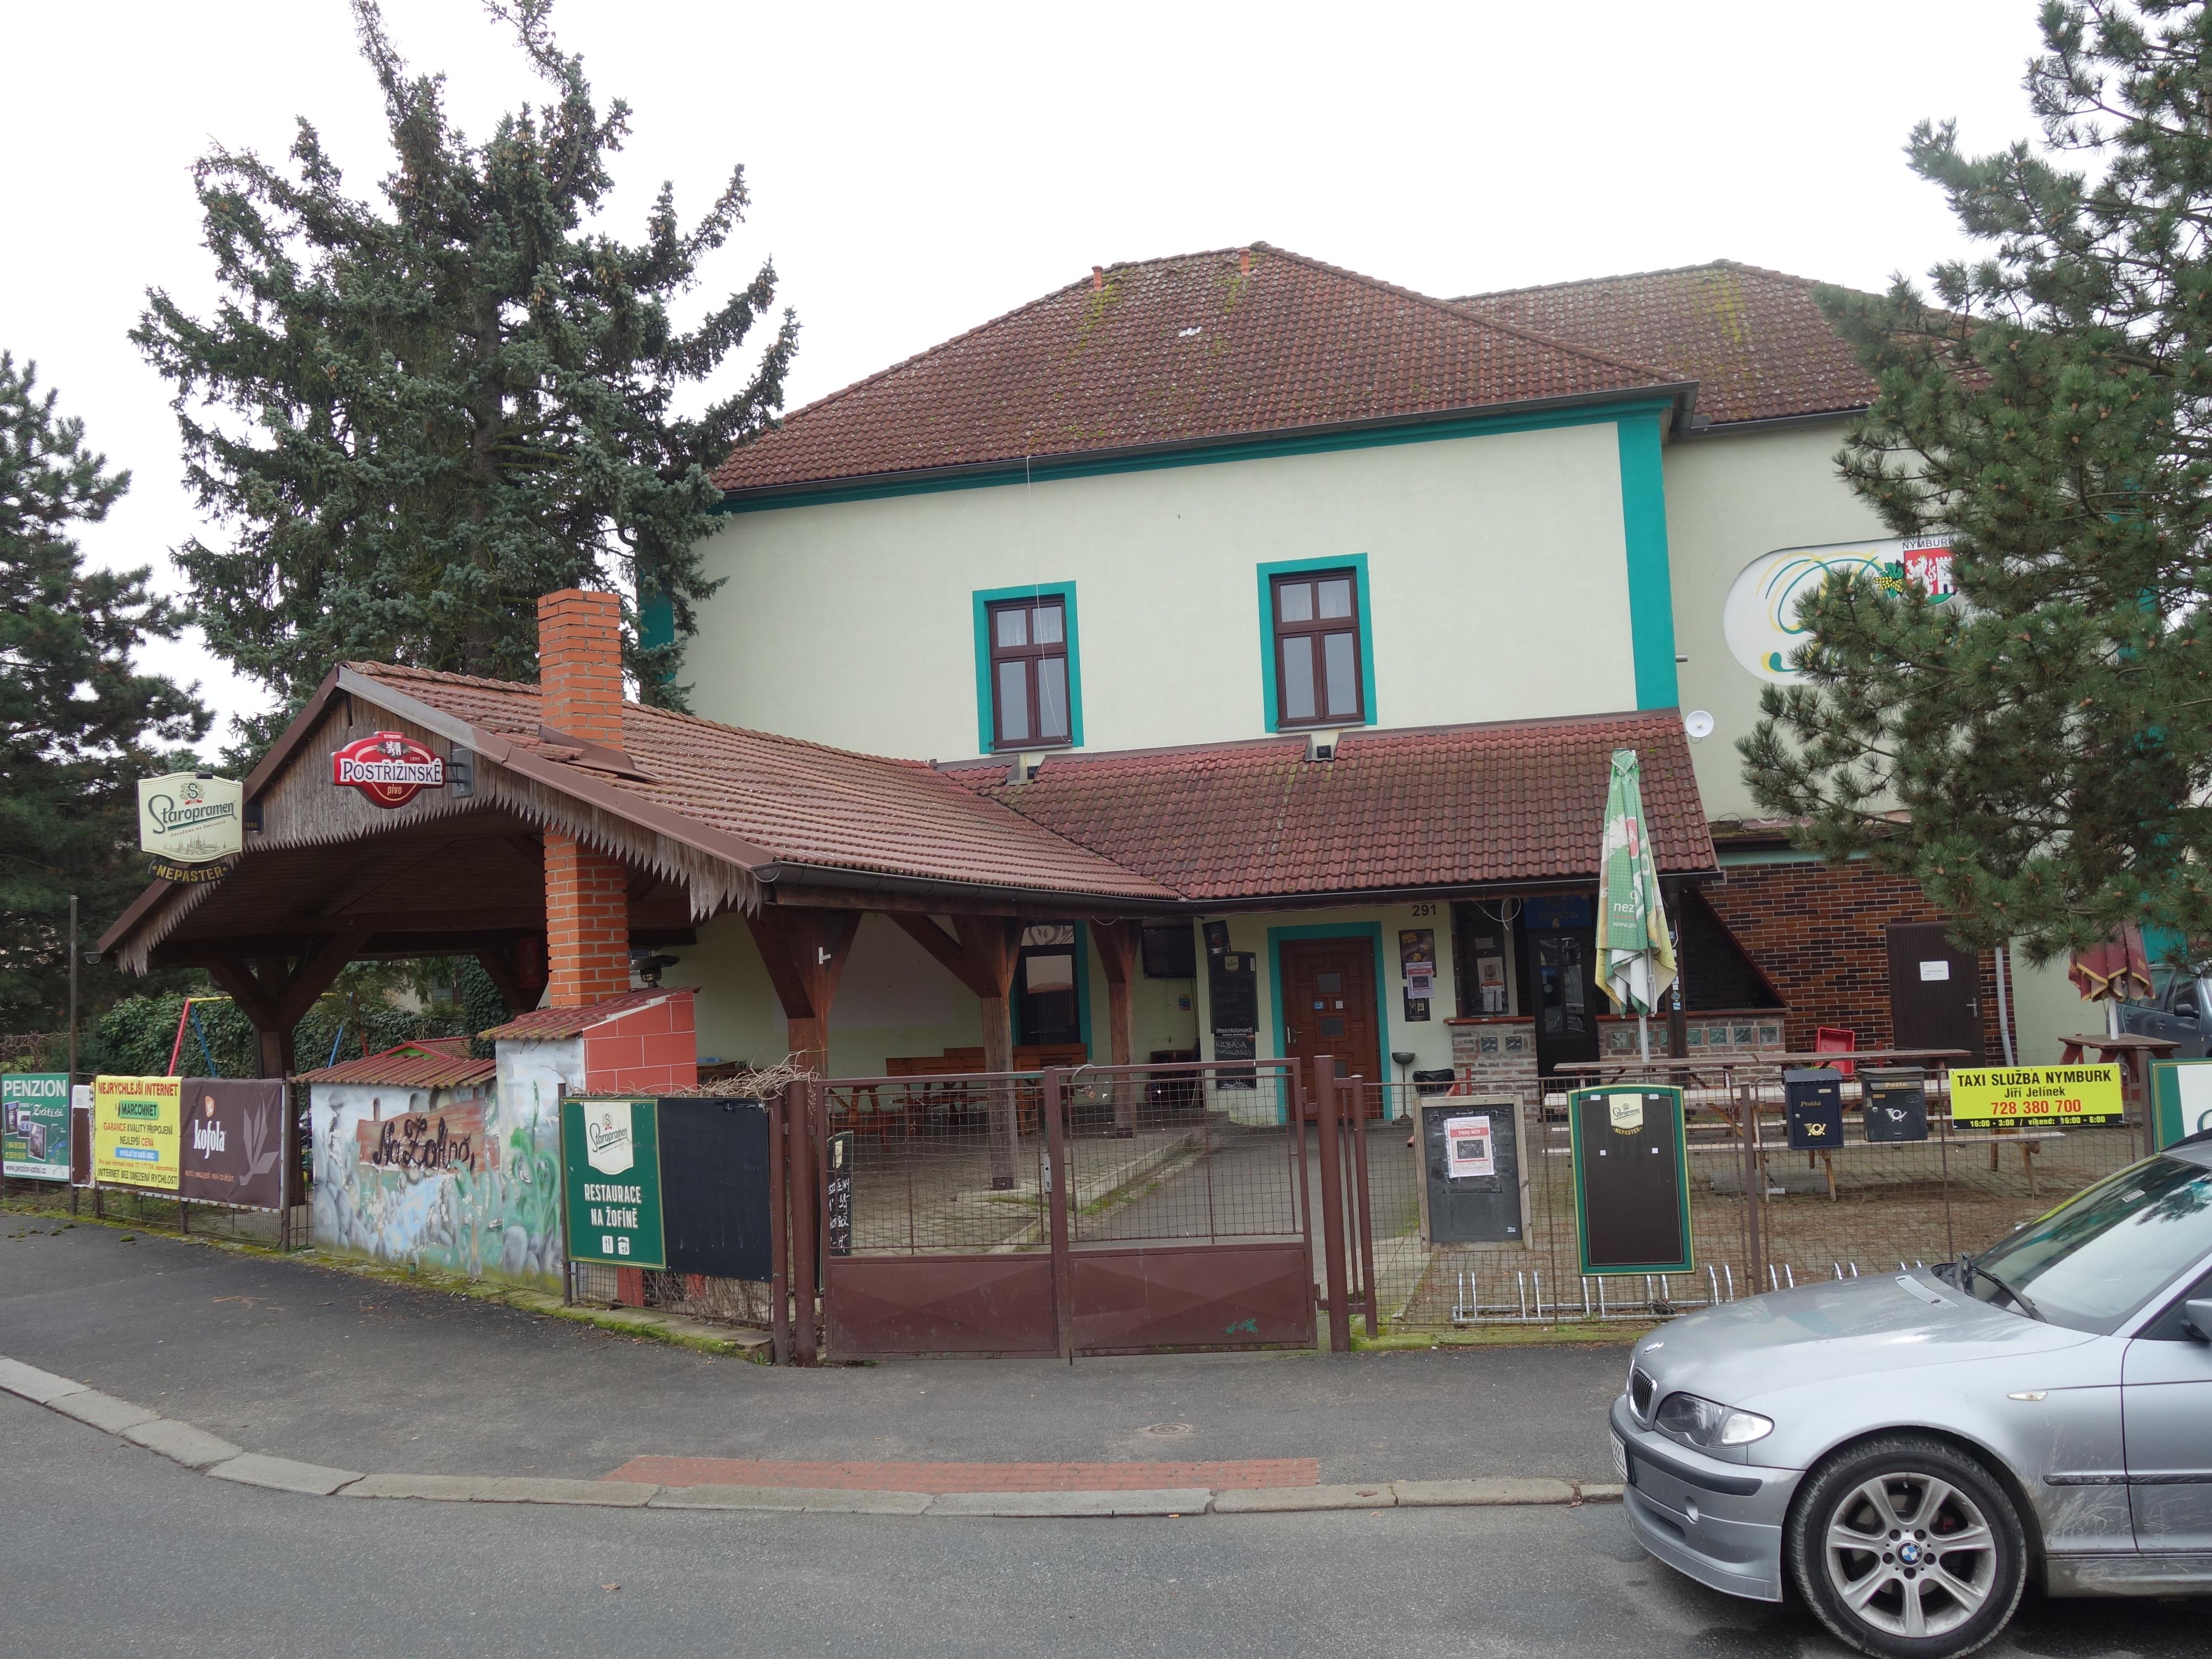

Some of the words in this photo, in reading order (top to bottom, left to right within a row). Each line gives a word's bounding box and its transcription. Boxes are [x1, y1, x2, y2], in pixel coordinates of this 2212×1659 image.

[343, 760, 441, 782] POSTŘIŽINSKÉ
[387, 784, 402, 796] pivo
[148, 794, 237, 834] Staropramen
[156, 864, 224, 882] NEPASTER
[1412, 904, 1436, 916] 291
[1957, 1074, 1986, 1087] TAXI
[1991, 1070, 2040, 1086] SLUŽBA
[2046, 1070, 2112, 1083] NYMBURK
[4, 1080, 66, 1097] PENZION
[98, 1081, 144, 1095] NEJRYCHLEJŠÍ
[145, 1083, 178, 1097] INTERNET
[2005, 1087, 2022, 1098] Jiří
[2026, 1087, 2066, 1098] Jelínek
[121, 1103, 157, 1117] MARCOMNET
[1991, 1101, 2017, 1115] 728
[2023, 1100, 2049, 1114] 380
[2055, 1099, 2081, 1113] 700
[103, 1123, 126, 1131] GARANCE
[127, 1124, 147, 1133] KVALITY
[147, 1124, 173, 1135] PŘIPOJENÍ
[2028, 1117, 2055, 1126] víkend:
[194, 1119, 225, 1159] kofola
[589, 1123, 629, 1152] Staropramen
[1615, 1127, 1641, 1135] NEPASTER
[120, 1136, 140, 1146] NEJLEPŠÍ
[141, 1138, 154, 1147] CENA
[97, 1168, 120, 1178] INTERNET
[121, 1170, 129, 1179] BEZ
[130, 1171, 150, 1182] OMEZENÍ
[151, 1173, 178, 1186] RYCHLOSTI
[584, 1184, 641, 1204] RESTAURACE
[591, 1208, 604, 1227] NA
[606, 1206, 638, 1229] ŽOFÍNĚ
